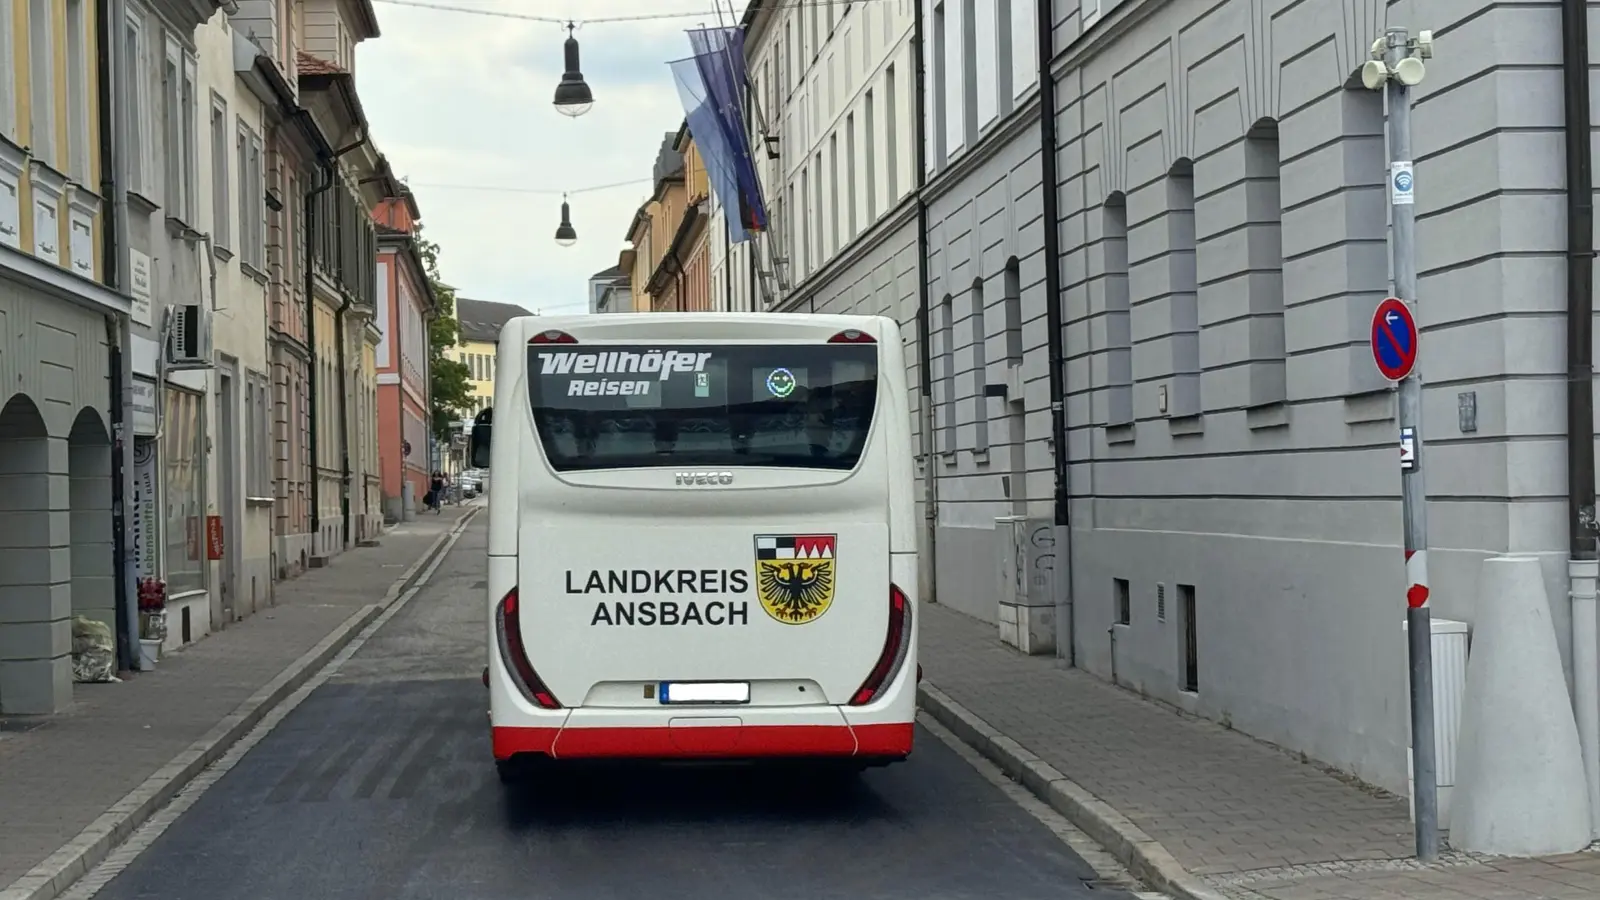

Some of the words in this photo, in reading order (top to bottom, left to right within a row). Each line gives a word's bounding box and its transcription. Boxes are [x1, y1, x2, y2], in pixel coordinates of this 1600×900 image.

[538, 350, 712, 381] Wellhöfer
[567, 379, 650, 397] Reisen
[675, 471, 734, 485] IVECO
[143, 499, 154, 576] Lebensmittel
[565, 569, 749, 594] LANDKREIS
[590, 601, 748, 626] ANSBACH
